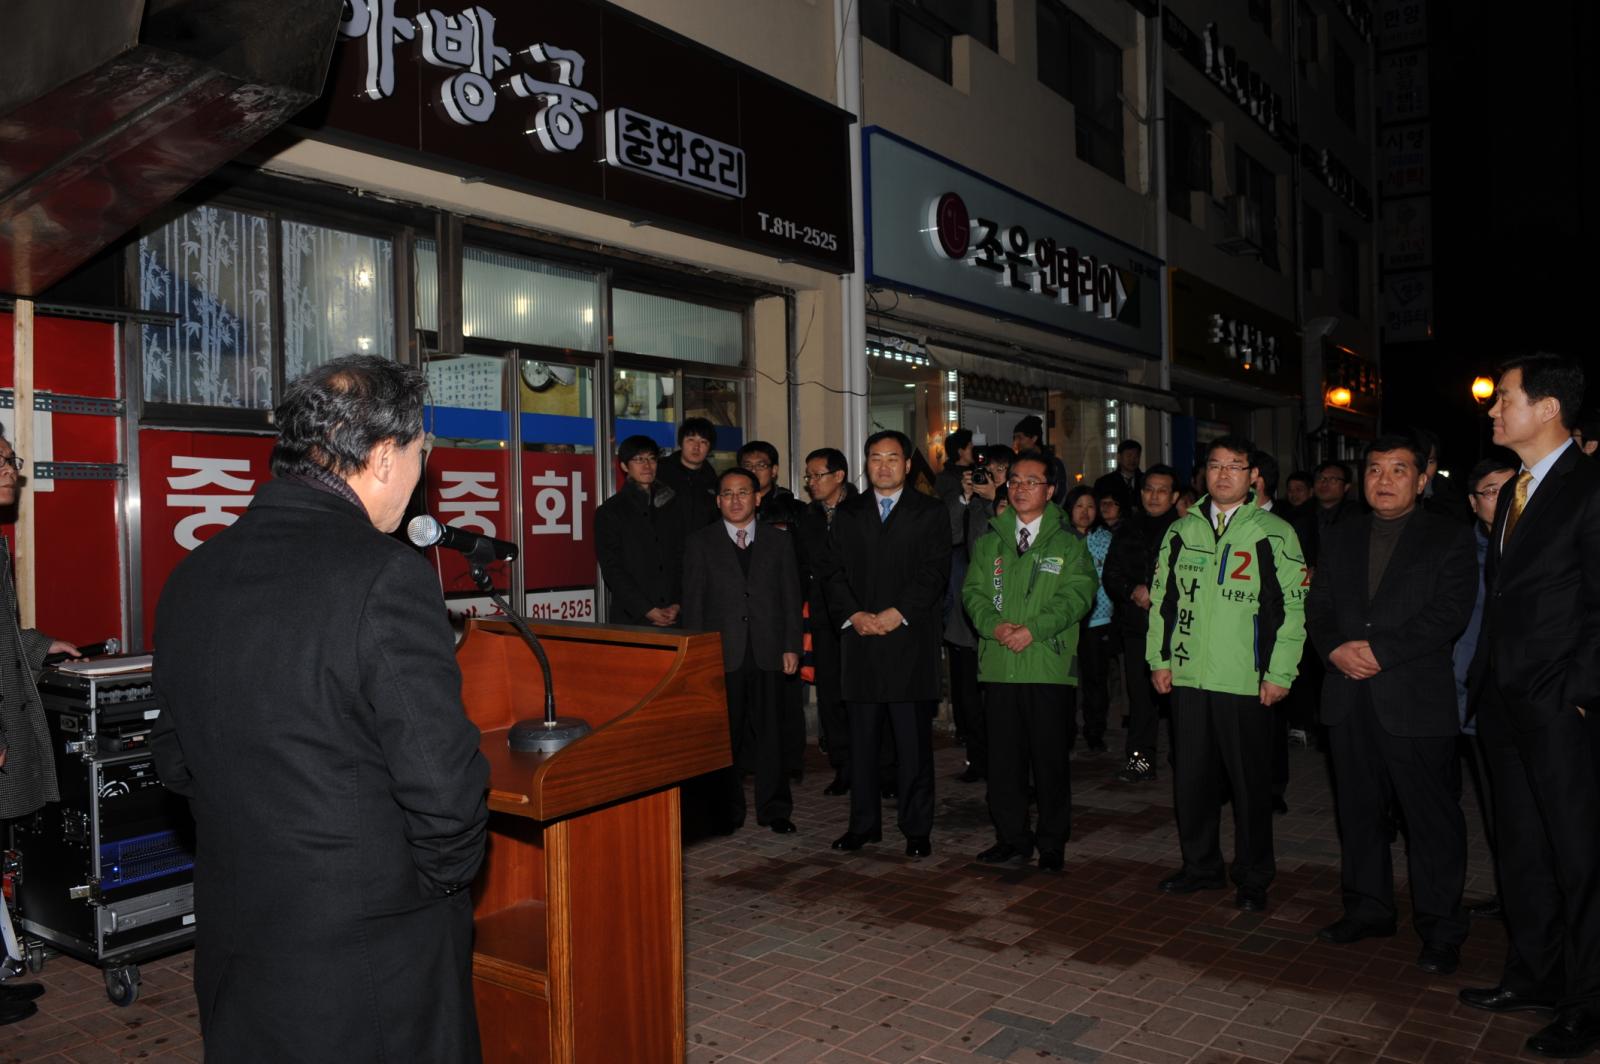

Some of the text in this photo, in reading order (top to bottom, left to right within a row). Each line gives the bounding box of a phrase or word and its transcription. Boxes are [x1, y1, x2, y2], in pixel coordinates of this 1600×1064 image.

[623, 113, 743, 195] 중화요리
[757, 211, 838, 252] T.811-2525
[1230, 550, 1253, 581] 2
[532, 598, 592, 620] 811-2525
[1222, 588, 1258, 604] 나완수
[1174, 577, 1201, 667] 나완수
